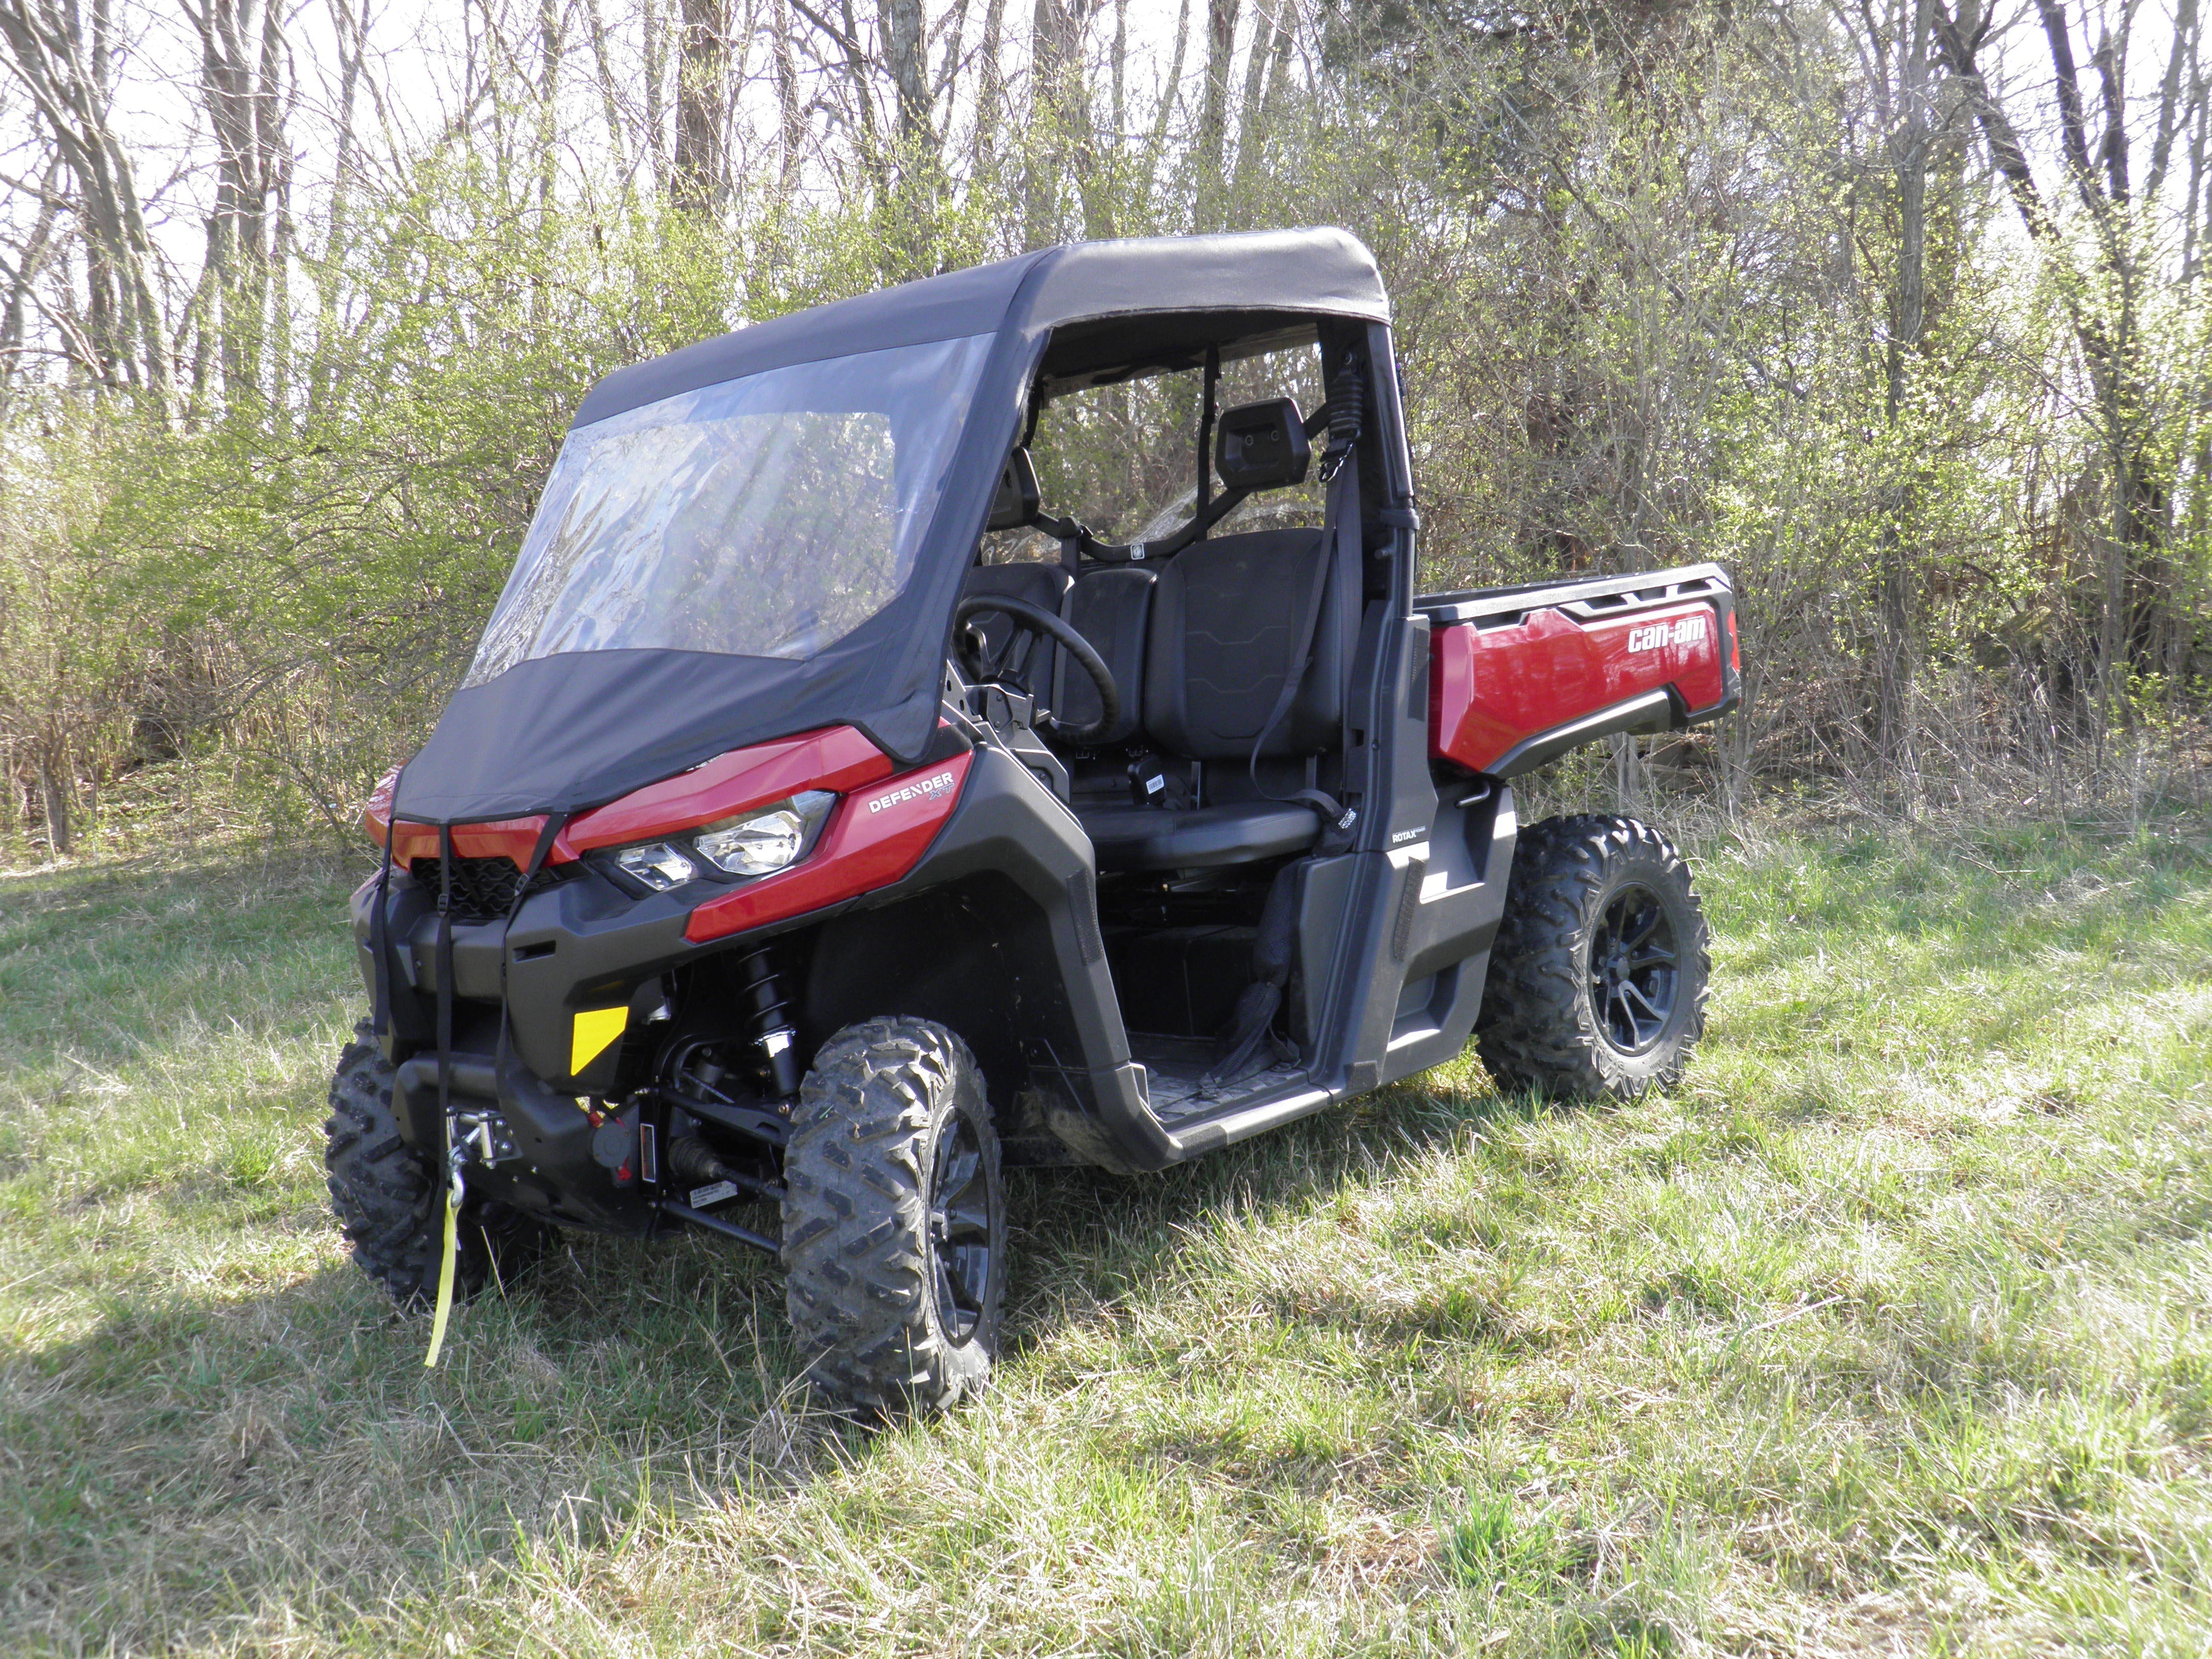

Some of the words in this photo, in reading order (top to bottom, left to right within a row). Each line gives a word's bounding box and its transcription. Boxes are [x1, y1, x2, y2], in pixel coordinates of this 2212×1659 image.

[869, 772, 953, 813] DEFENDER
[929, 783, 954, 800] XT
[1392, 830, 1417, 843] ROTAX
